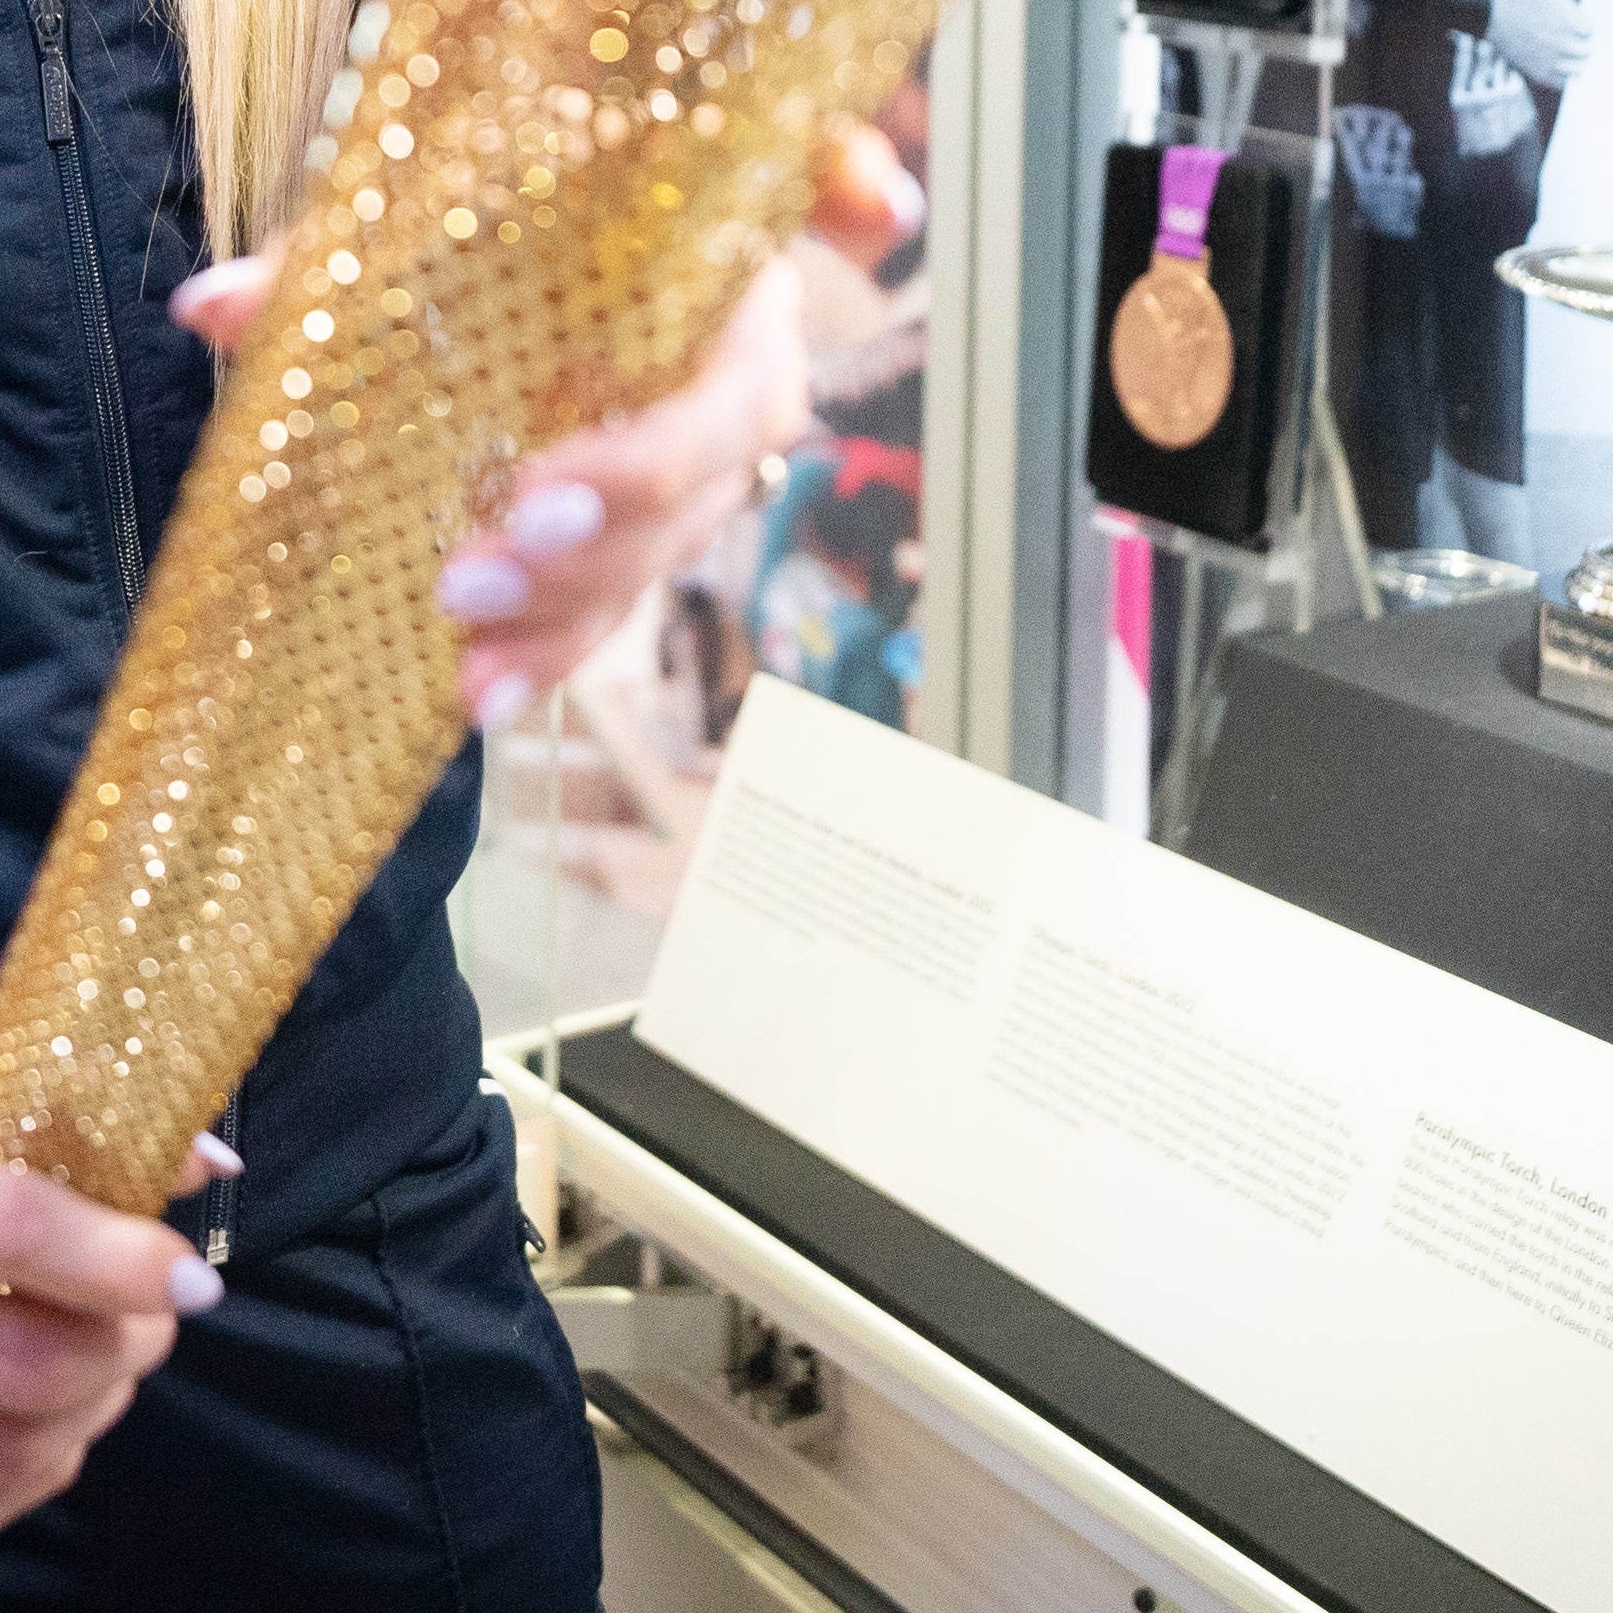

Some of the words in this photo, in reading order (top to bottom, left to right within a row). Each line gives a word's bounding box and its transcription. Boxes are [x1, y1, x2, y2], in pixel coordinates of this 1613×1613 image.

[1414, 1111, 1496, 1164] Paralympic
[1499, 1151, 1544, 1191] Torch,
[1549, 1178, 1608, 1220] London
[1563, 1237, 1610, 1270] London
[1548, 1304, 1592, 1339] Queen
